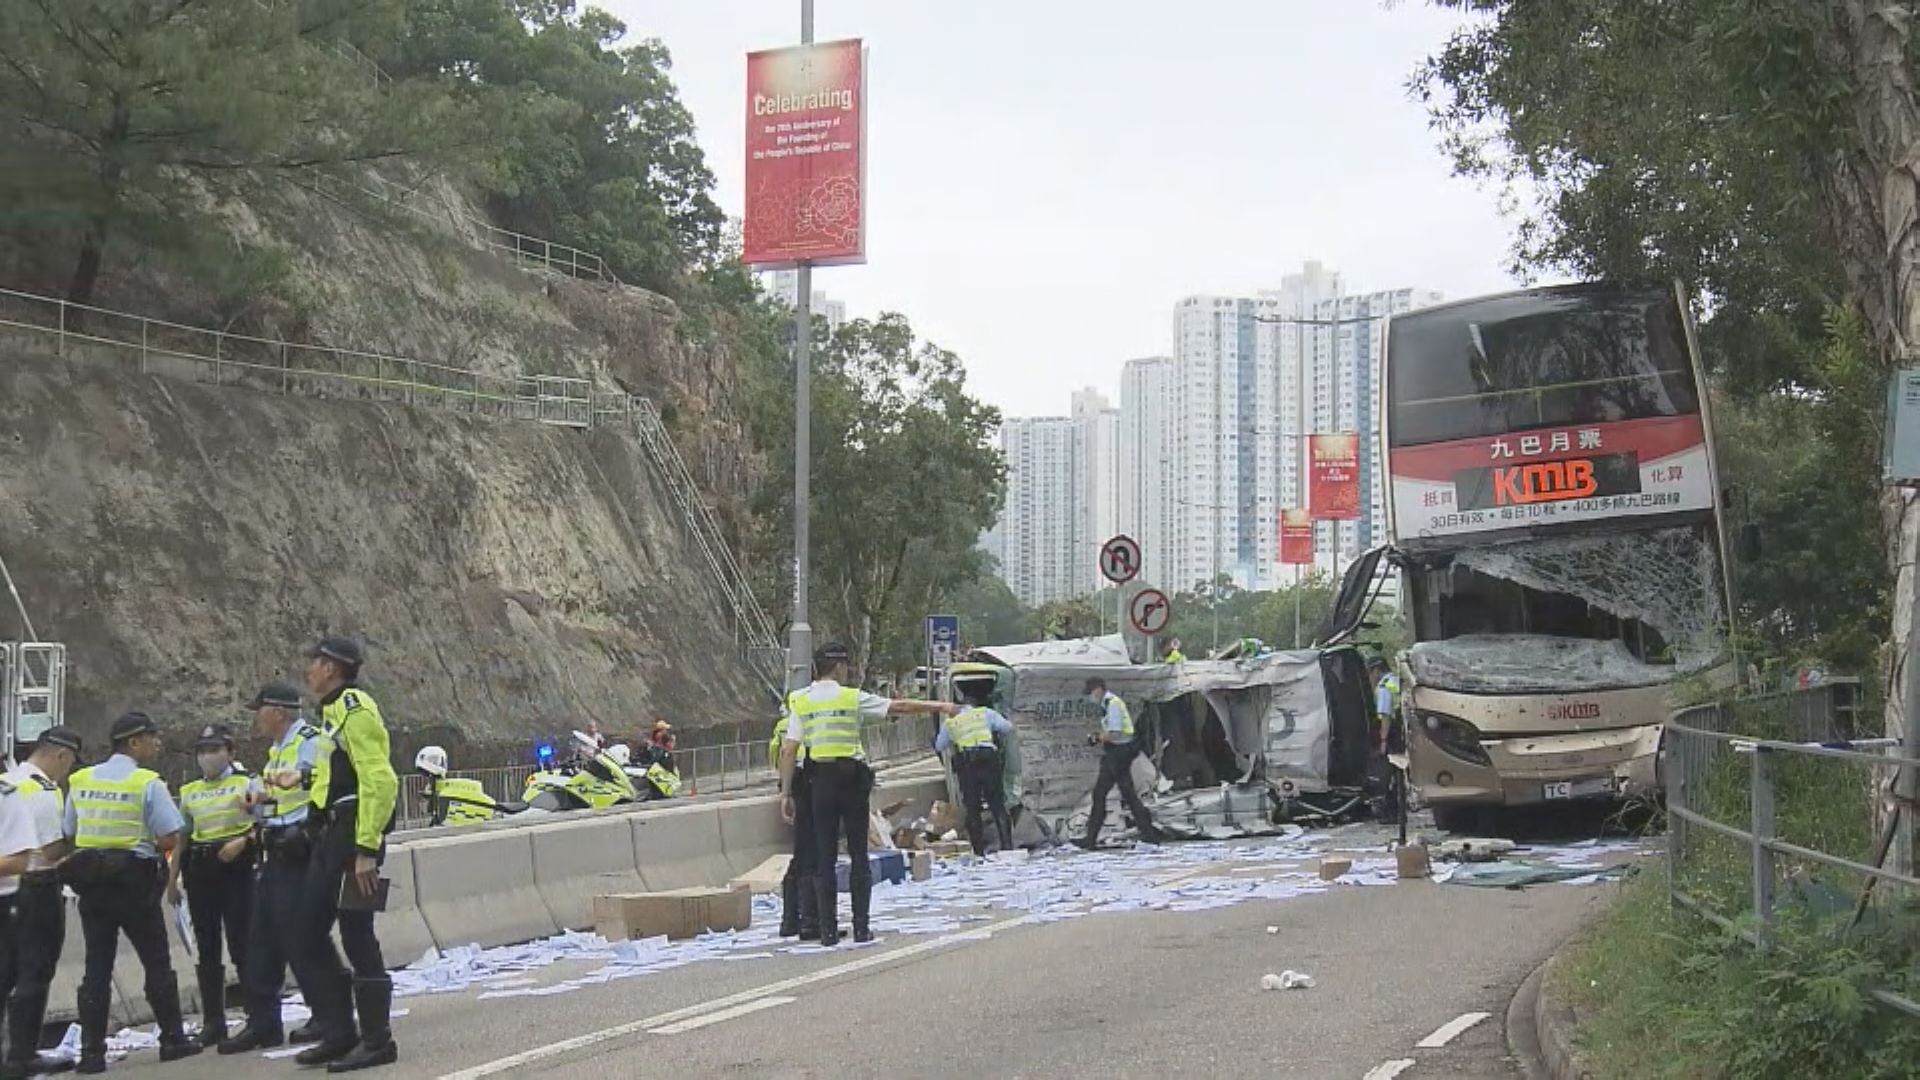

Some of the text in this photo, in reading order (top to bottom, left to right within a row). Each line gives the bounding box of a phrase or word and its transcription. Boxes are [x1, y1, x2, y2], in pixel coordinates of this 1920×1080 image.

[754, 88, 852, 115] Celebrating
[1490, 429, 1603, 459] 九巴月票
[1493, 459, 1598, 504] KMB
[1651, 465, 1684, 483] 化算
[1547, 784, 1567, 797] TC
